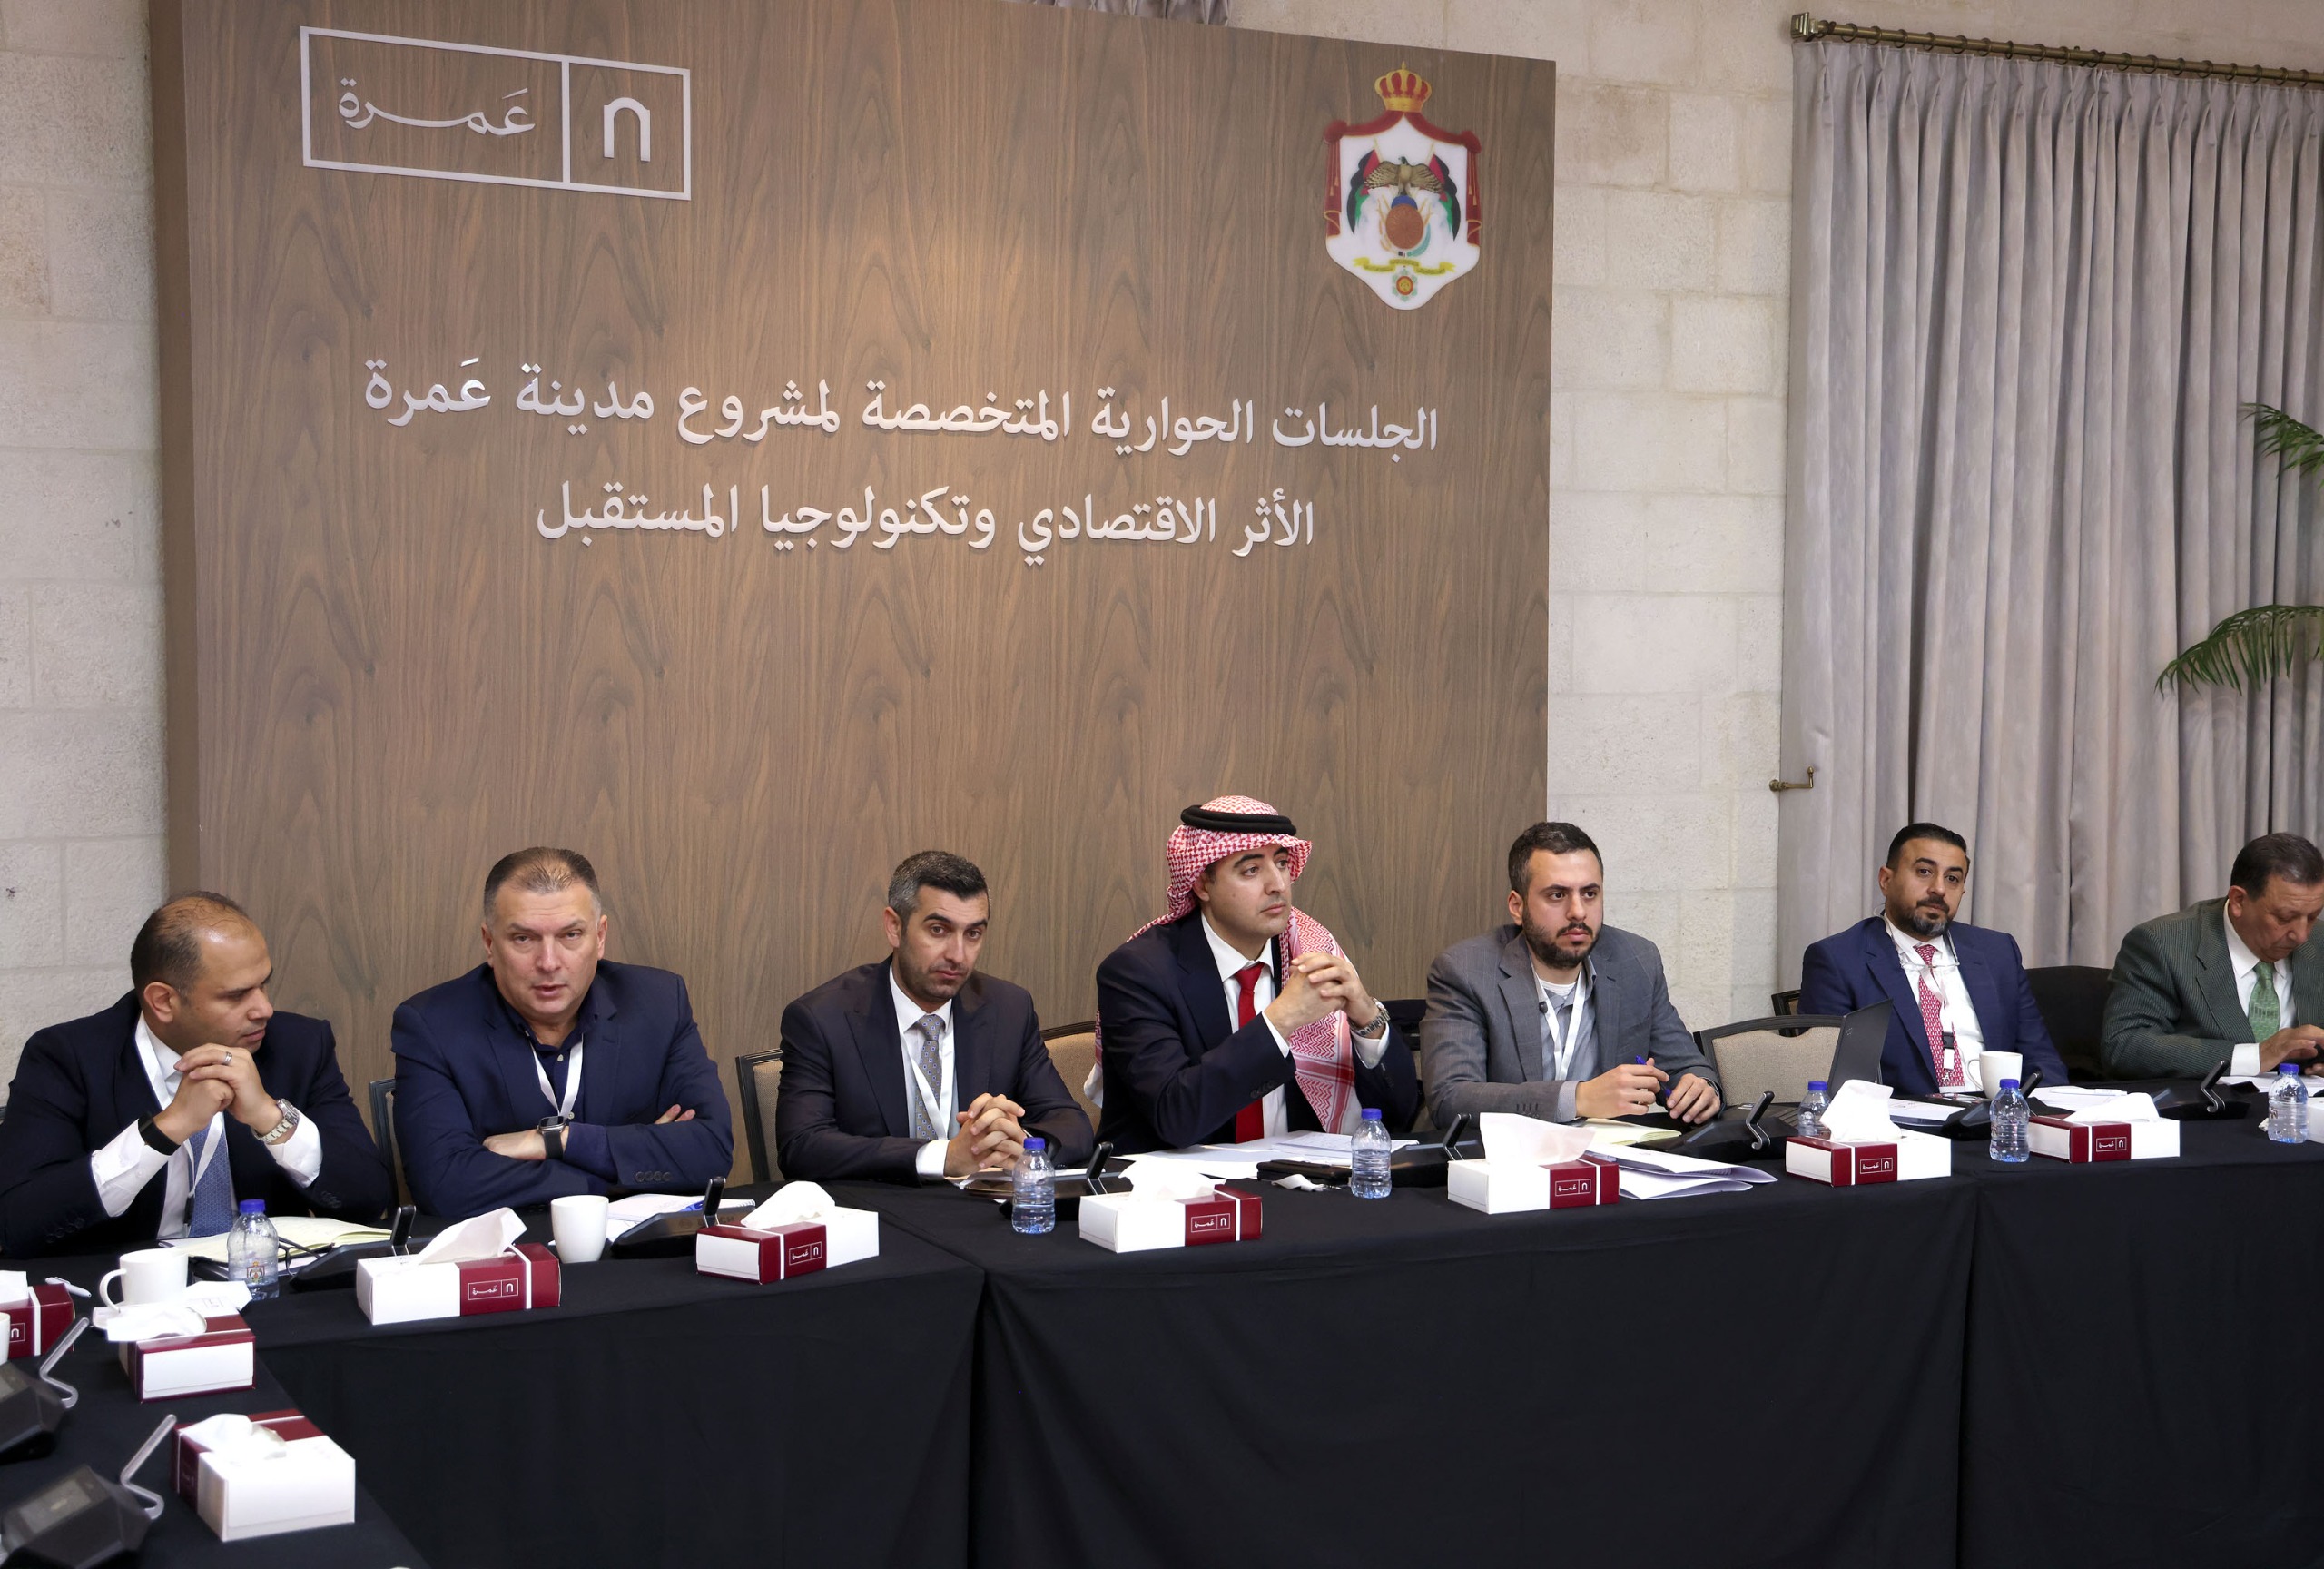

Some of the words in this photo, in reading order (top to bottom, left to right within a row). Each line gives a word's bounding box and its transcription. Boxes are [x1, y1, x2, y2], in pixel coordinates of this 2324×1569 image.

[515, 359, 655, 436] مدينة
[677, 378, 841, 445] لمشروع
[862, 377, 1071, 442] المتخصصة
[1091, 386, 1254, 457] الحوارية
[1271, 401, 1438, 464] الجلسات
[536, 478, 739, 547] المستقبل
[761, 483, 997, 551] وتكنولوجيا
[1017, 492, 1217, 567] الاقتصادي
[1231, 486, 1315, 558] الأثر
